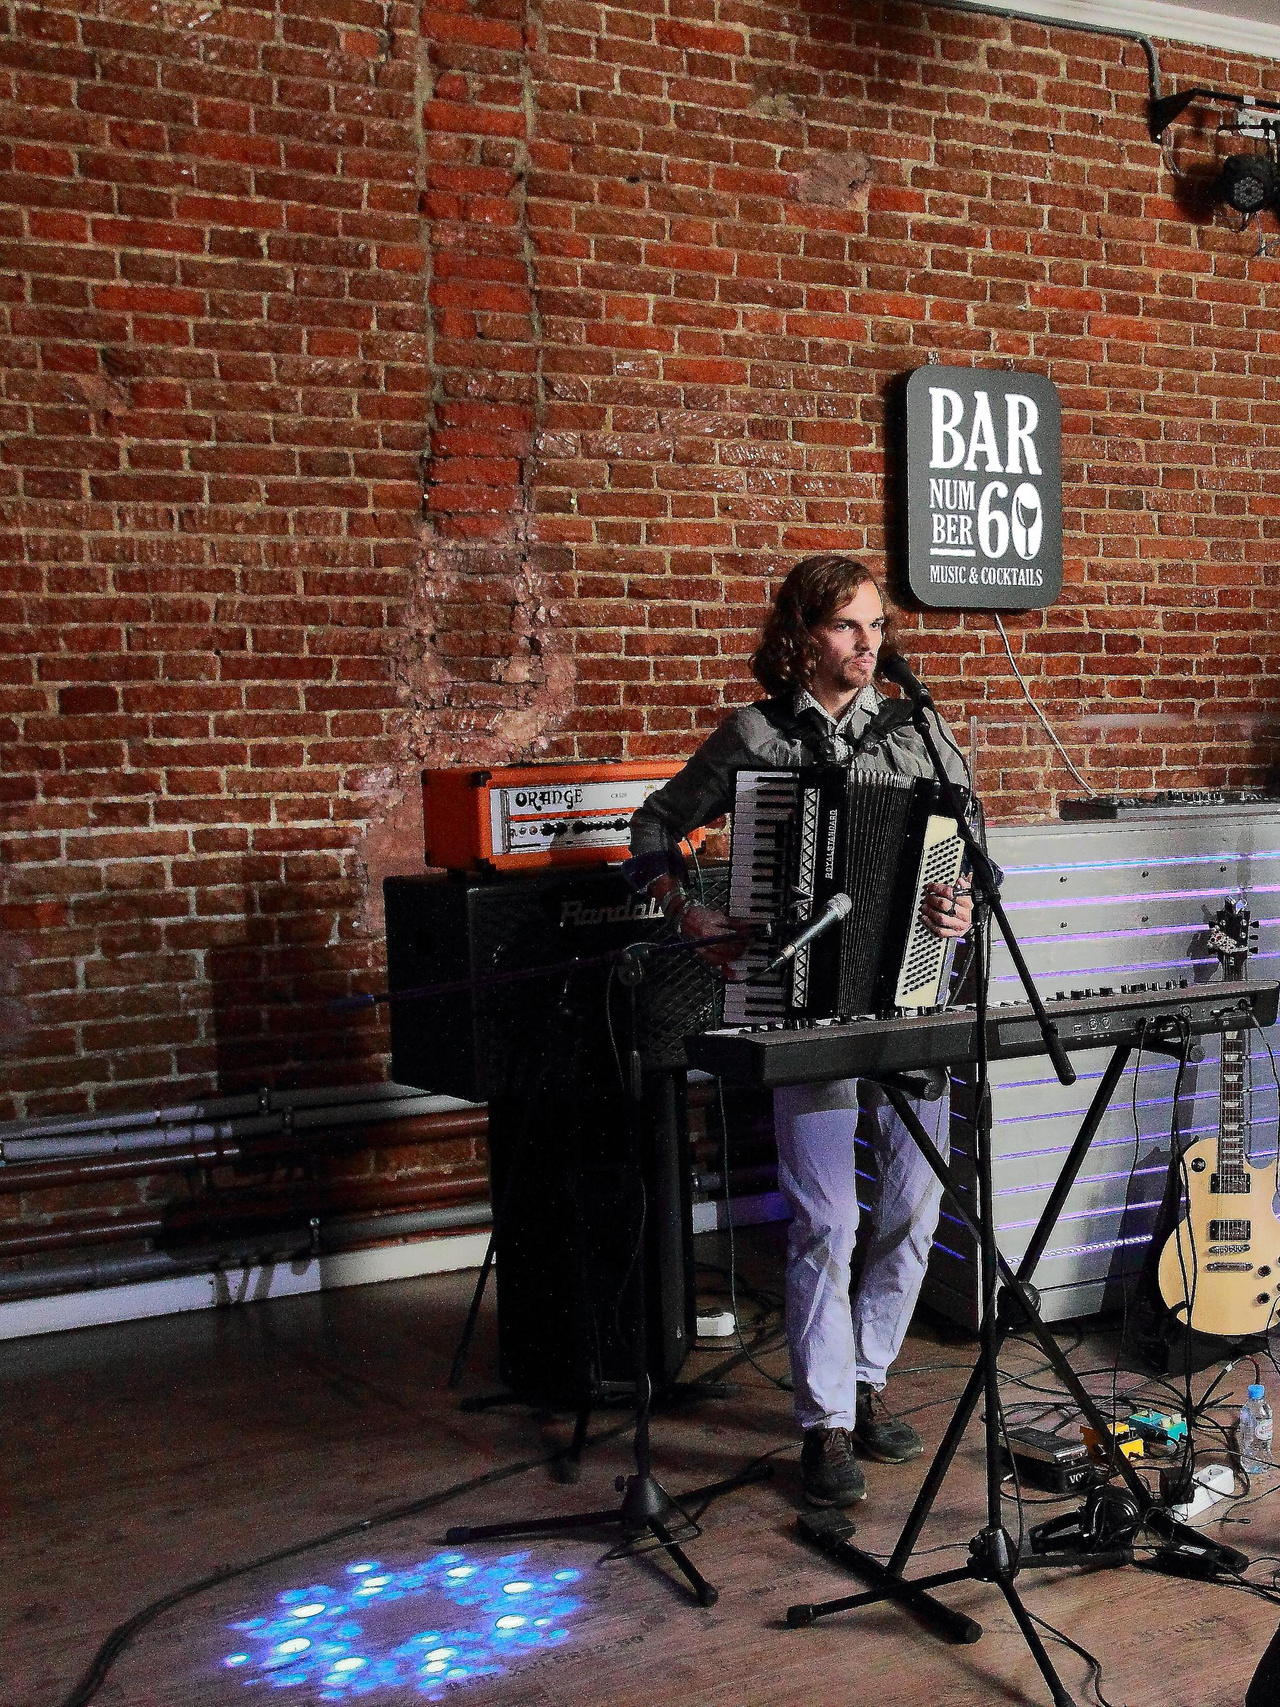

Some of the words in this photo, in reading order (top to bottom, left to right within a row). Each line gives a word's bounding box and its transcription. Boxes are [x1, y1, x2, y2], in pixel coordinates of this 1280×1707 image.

[928, 387, 1042, 475] BAR
[929, 478, 976, 510] NUM
[931, 514, 974, 545] BER
[977, 480, 1043, 560] 60
[929, 565, 966, 584] MUSIC
[968, 567, 979, 585] &
[981, 567, 1043, 586] COCKTAILS
[515, 788, 583, 811] ORANGE
